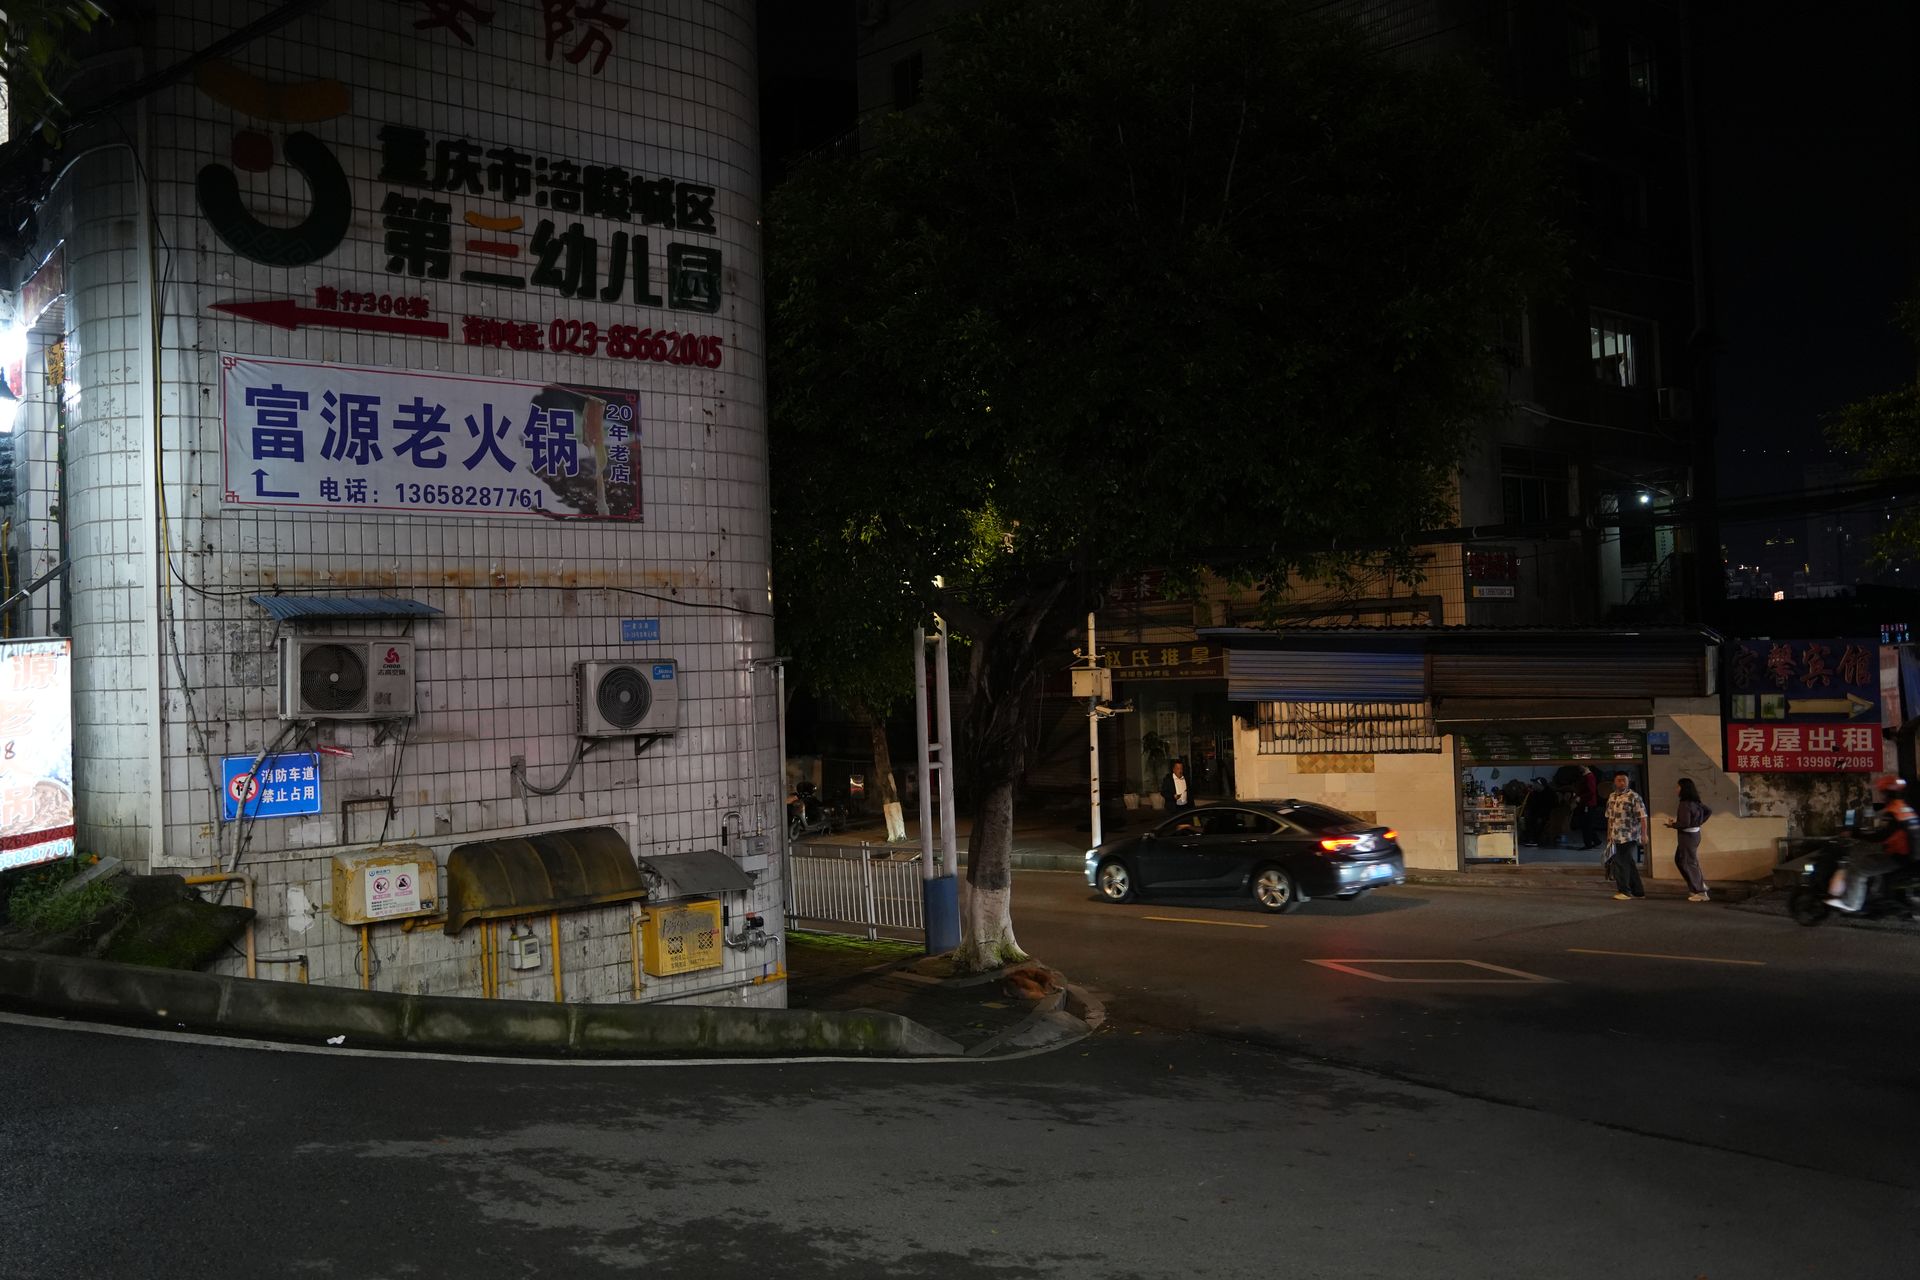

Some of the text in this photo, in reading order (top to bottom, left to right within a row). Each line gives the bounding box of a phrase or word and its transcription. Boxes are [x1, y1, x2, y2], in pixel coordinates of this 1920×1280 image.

[378, 125, 717, 234] 重庆市涪陵城区
[381, 192, 722, 313] 第三幼儿园
[549, 318, 723, 369] 023-85662005
[246, 384, 580, 477] 富源老火锅
[395, 482, 543, 509] 13658287761
[1736, 727, 1874, 752] 房屋出租
[261, 766, 315, 783] 消防车道
[261, 786, 315, 804] 禁止占用
